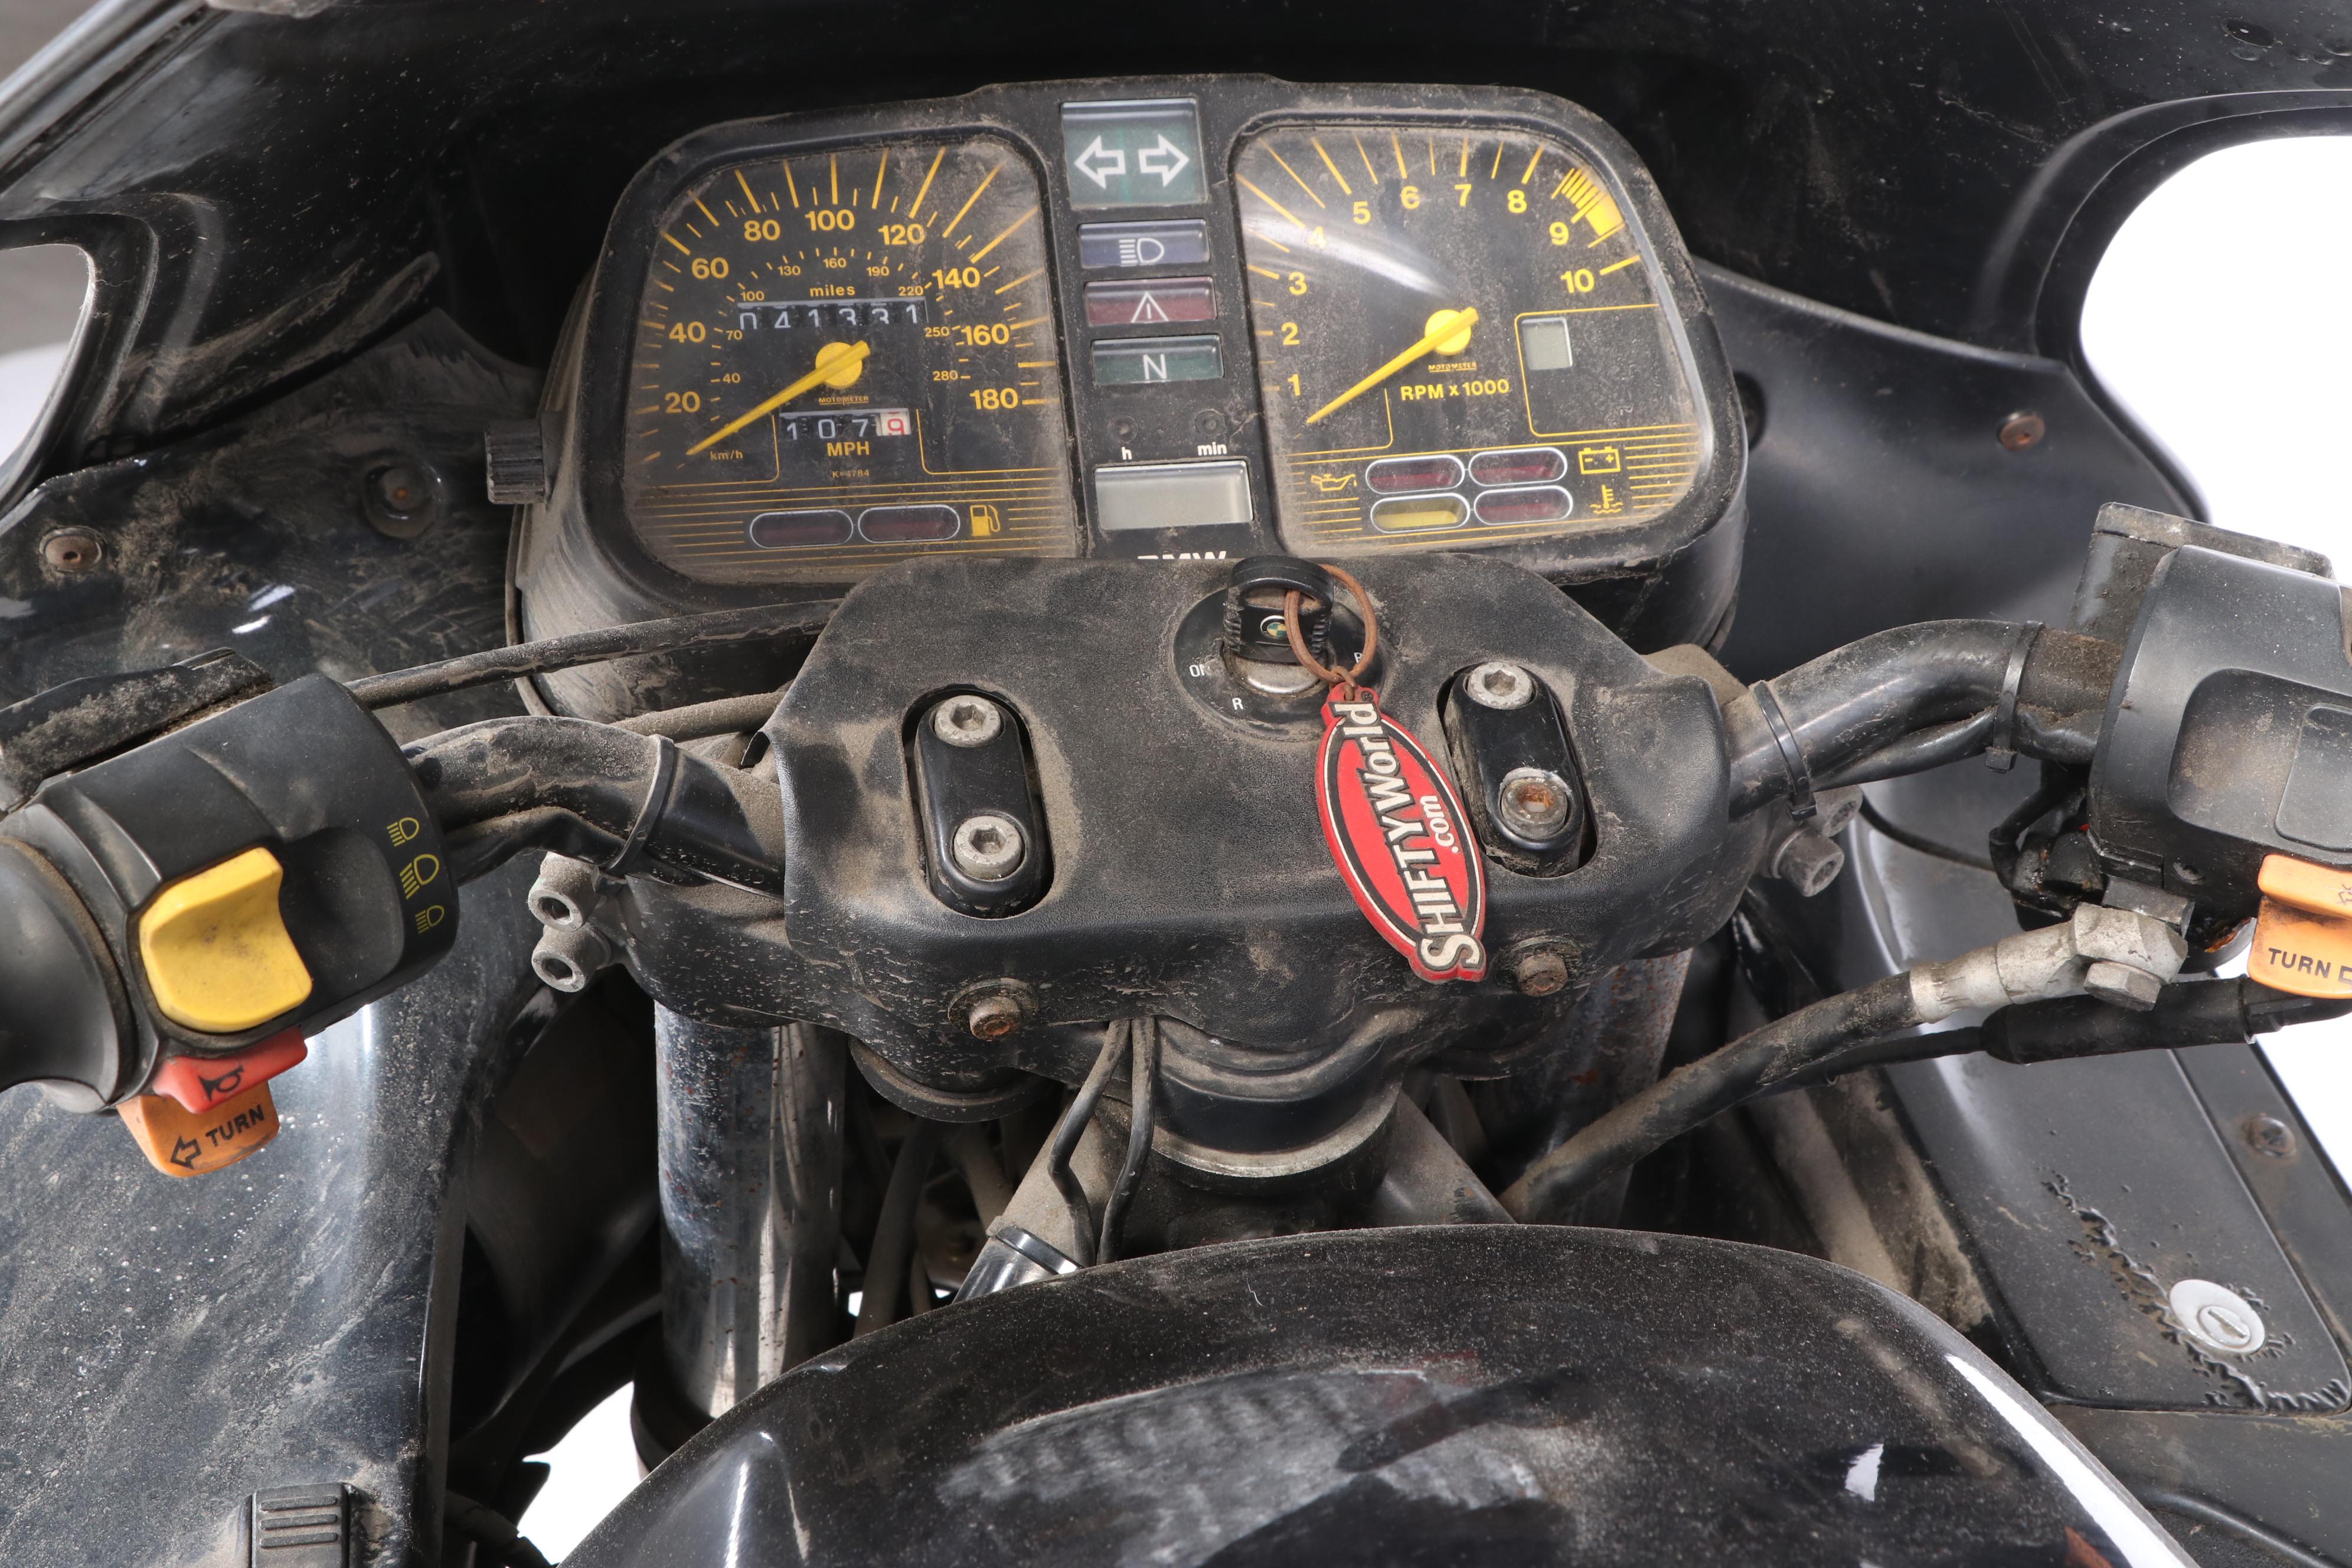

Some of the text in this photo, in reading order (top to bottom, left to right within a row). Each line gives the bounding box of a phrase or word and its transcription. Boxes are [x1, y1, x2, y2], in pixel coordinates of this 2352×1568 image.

[1400, 185, 1420, 209] 6
[1454, 184, 1472, 207] 7
[1507, 190, 1527, 213] 8
[805, 209, 855, 231] 100
[1353, 201, 1371, 224] 5
[744, 220, 780, 241] 80
[878, 223, 926, 245] 120
[1308, 226, 1327, 249] 4
[1549, 221, 1569, 245] 9
[691, 257, 729, 279] 60
[778, 266, 801, 276] 130
[823, 258, 847, 268] 160
[866, 266, 890, 276] 190
[932, 267, 980, 289] 140
[1289, 272, 1307, 295] 3
[1560, 269, 1595, 293] 10
[740, 290, 765, 301] 100
[809, 285, 855, 297] miles
[898, 285, 924, 296] 220
[669, 321, 706, 343] 40
[726, 330, 743, 340] 70
[925, 328, 949, 338] 250
[961, 324, 1010, 345] 160
[1281, 322, 1300, 345] 2
[723, 373, 741, 383] 40
[933, 370, 959, 381] 280
[1142, 354, 1168, 380] N
[1288, 374, 1301, 396] 1
[1400, 384, 1444, 401] RPM
[1462, 378, 1510, 396] 1000
[664, 391, 701, 414] 20
[818, 396, 870, 405] MOTOMETER
[969, 387, 1019, 410] 180
[710, 450, 743, 460] km/h
[827, 441, 870, 456] MPH
[1122, 446, 1132, 460] h
[1197, 442, 1227, 456] min
[1231, 697, 1244, 710] R
[2268, 947, 2332, 978] TURN
[205, 1104, 265, 1147] TURN
